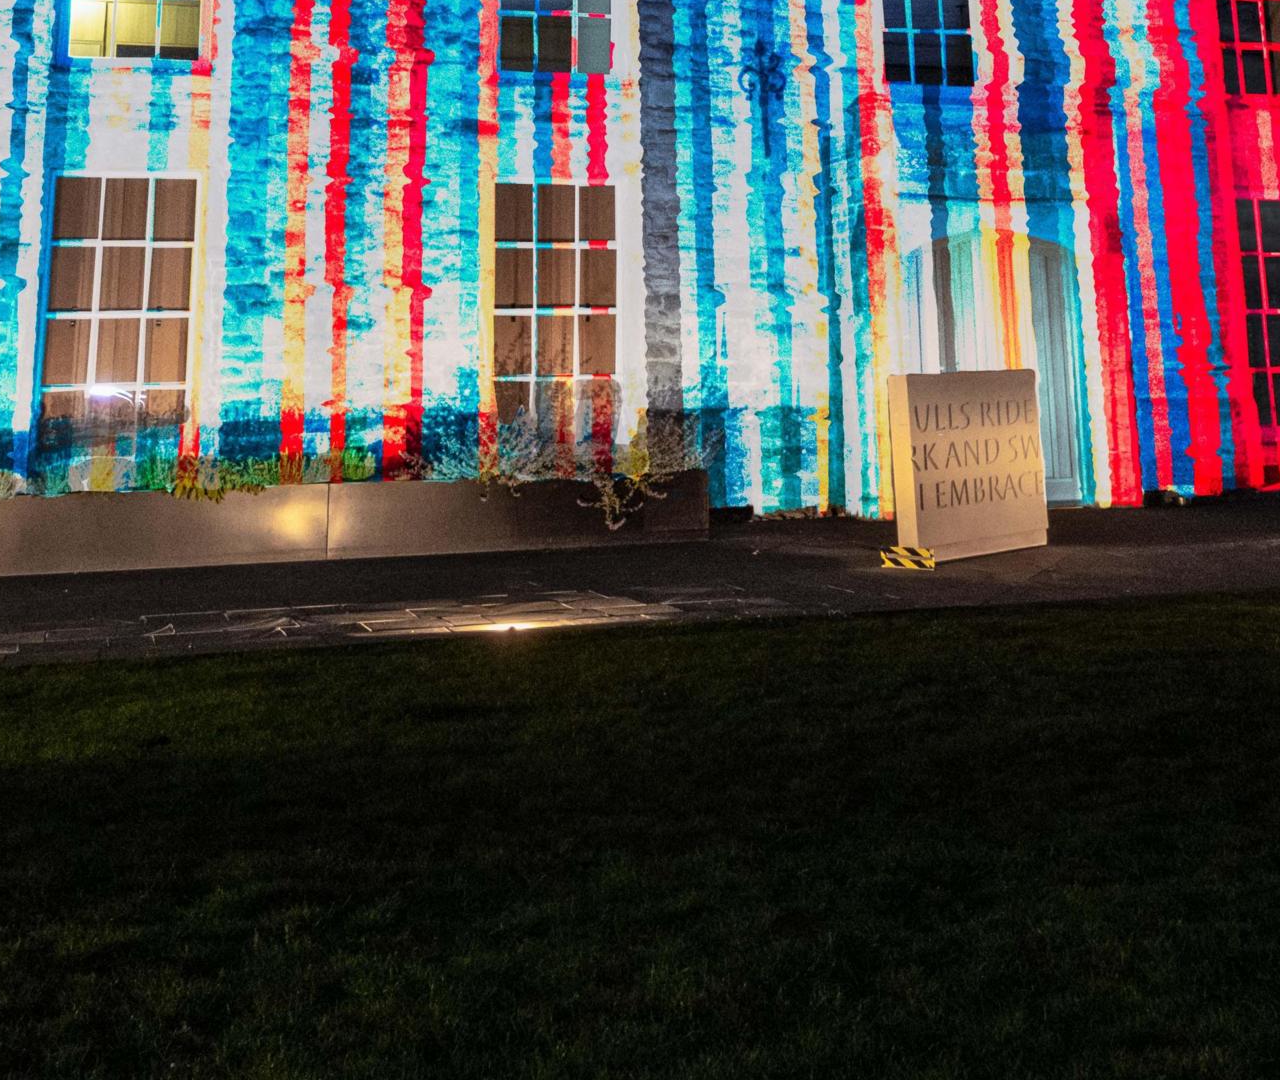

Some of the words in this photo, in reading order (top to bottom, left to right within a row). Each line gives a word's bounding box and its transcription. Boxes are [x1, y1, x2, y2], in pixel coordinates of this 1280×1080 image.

[914, 402, 970, 432] ULLS
[980, 400, 1034, 427] RIDE
[945, 439, 1000, 469] AND
[1008, 434, 1040, 463] SW
[919, 483, 924, 511] I
[935, 471, 1044, 509] EMBRACE
